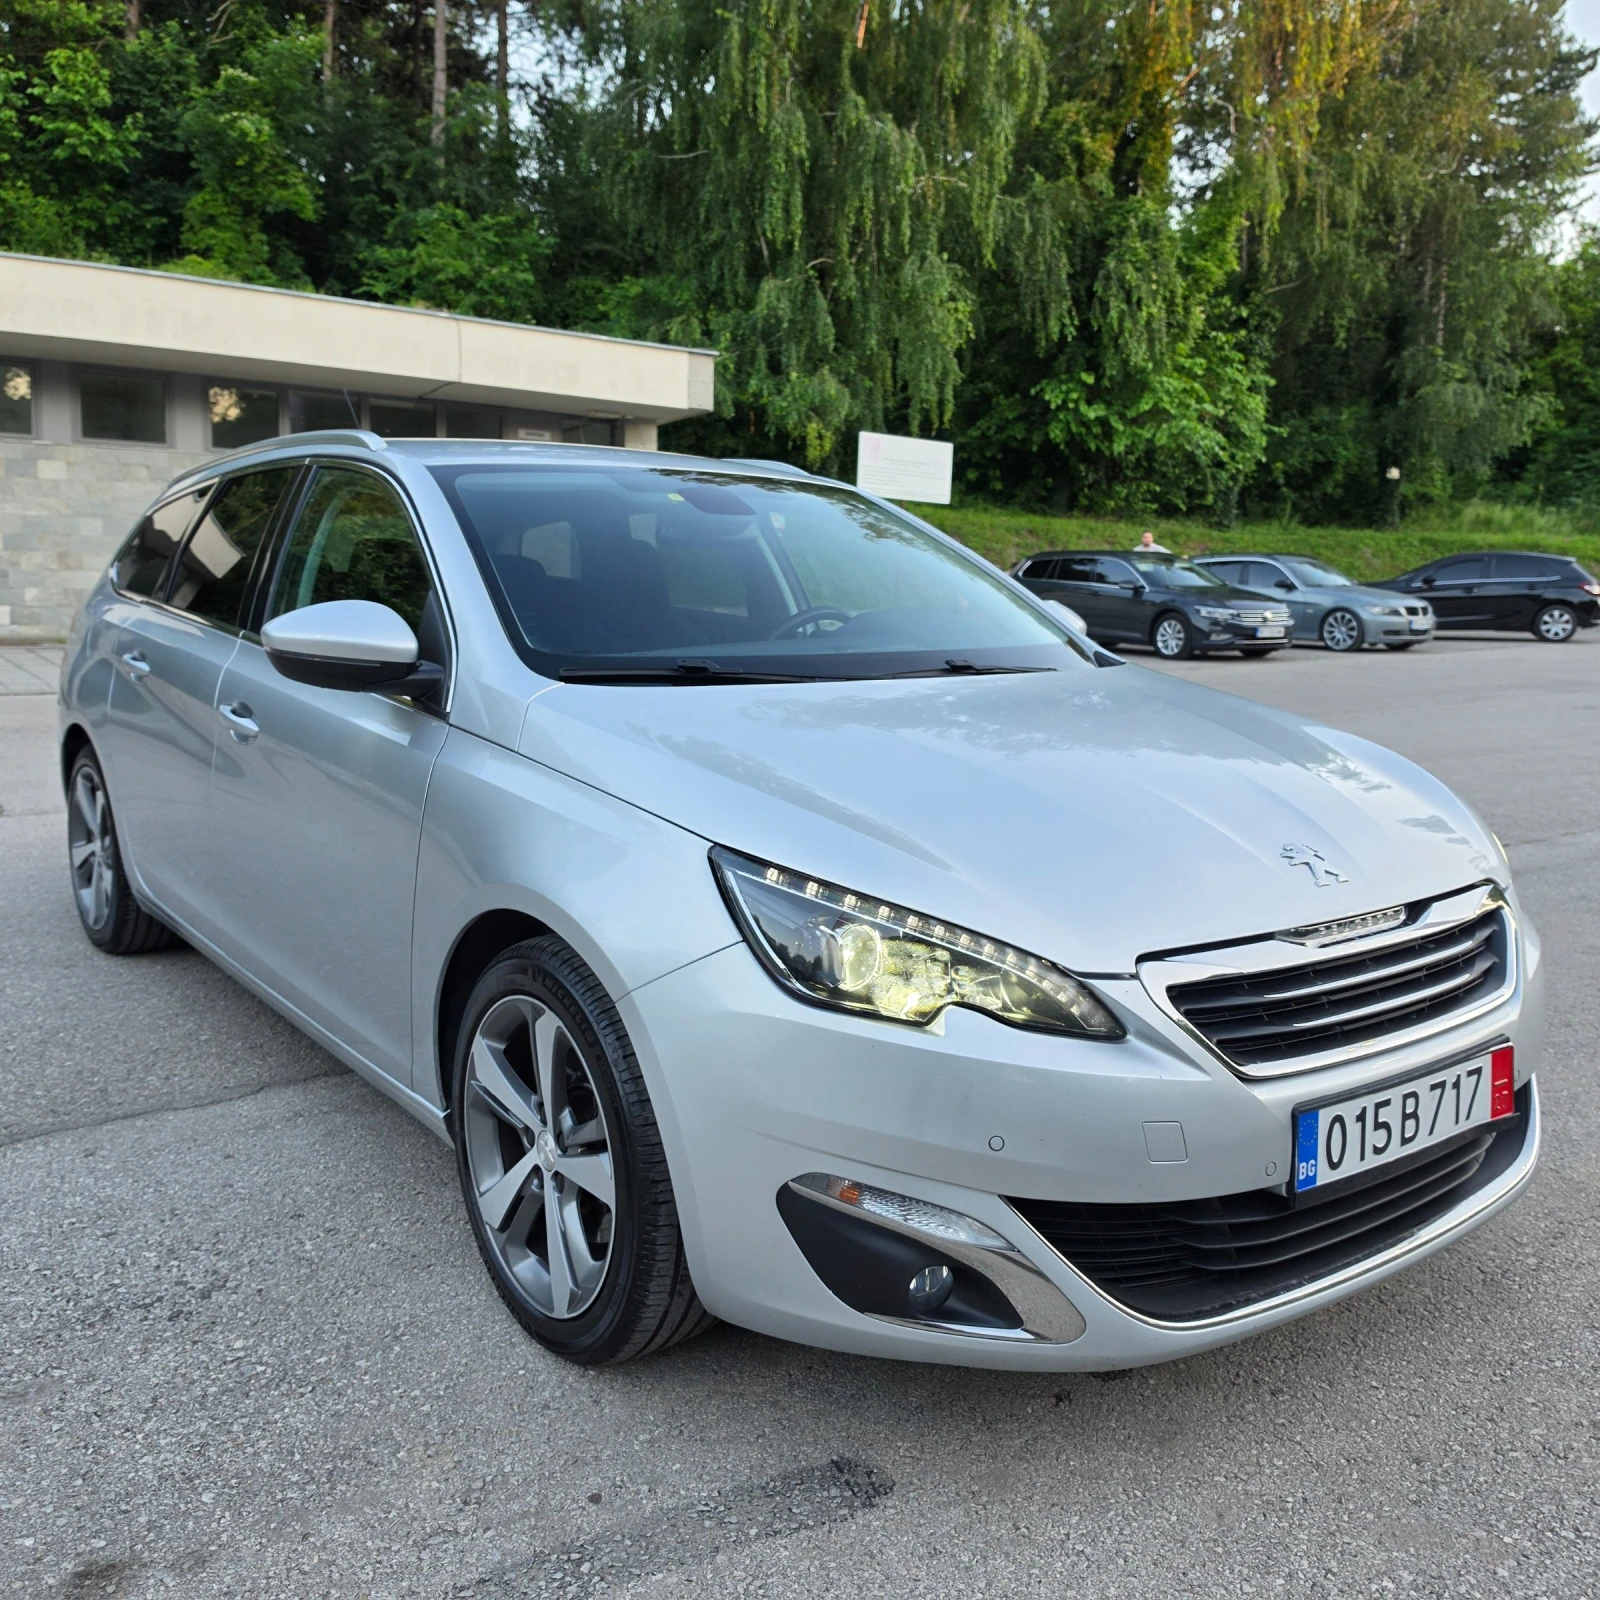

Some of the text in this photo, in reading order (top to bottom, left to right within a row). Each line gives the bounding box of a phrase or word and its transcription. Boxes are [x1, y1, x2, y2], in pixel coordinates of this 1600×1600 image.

[544, 977, 595, 1044] MICHELIN
[1326, 1063, 1483, 1171] 015B717
[1299, 1160, 1316, 1181] BG
